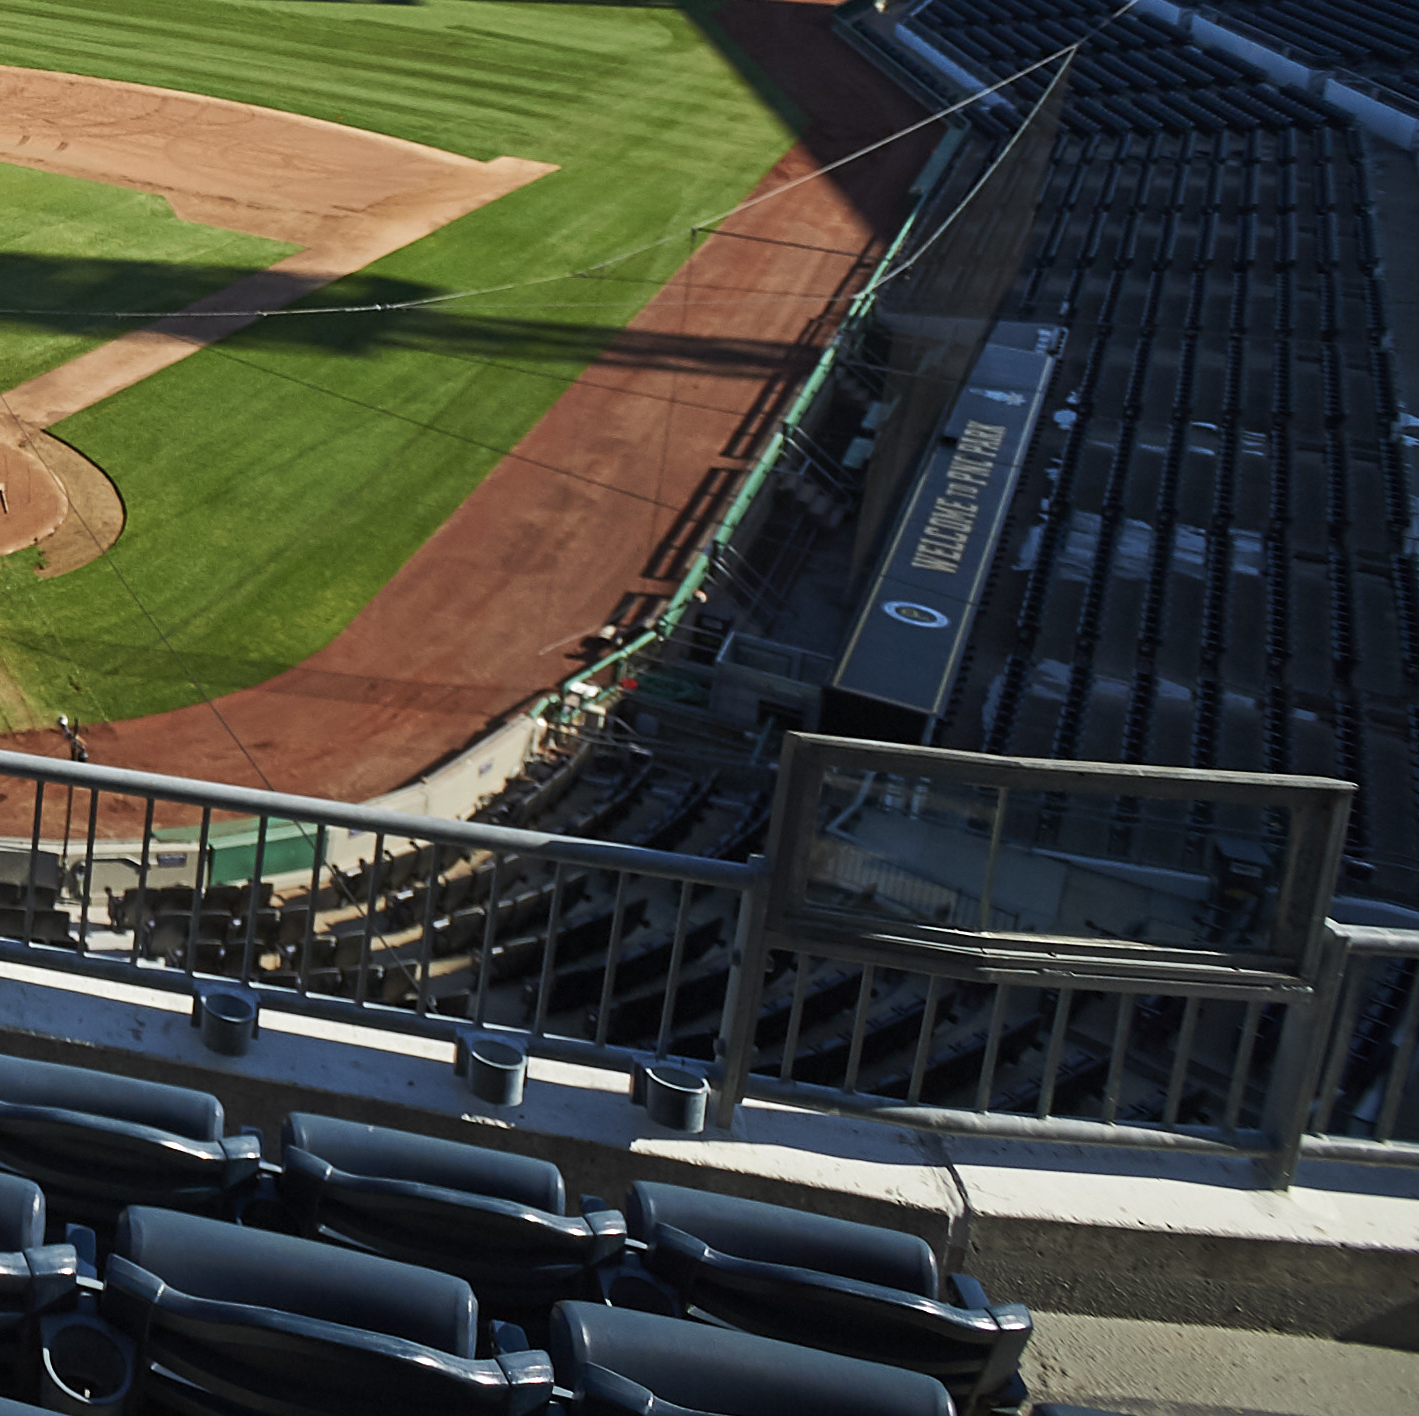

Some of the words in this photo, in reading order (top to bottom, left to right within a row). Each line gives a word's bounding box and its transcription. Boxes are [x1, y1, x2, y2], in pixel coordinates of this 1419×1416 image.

[957, 419, 1007, 459] PARK
[946, 454, 995, 486] PNC
[946, 482, 979, 499] TO
[911, 497, 980, 574] WELCOME
